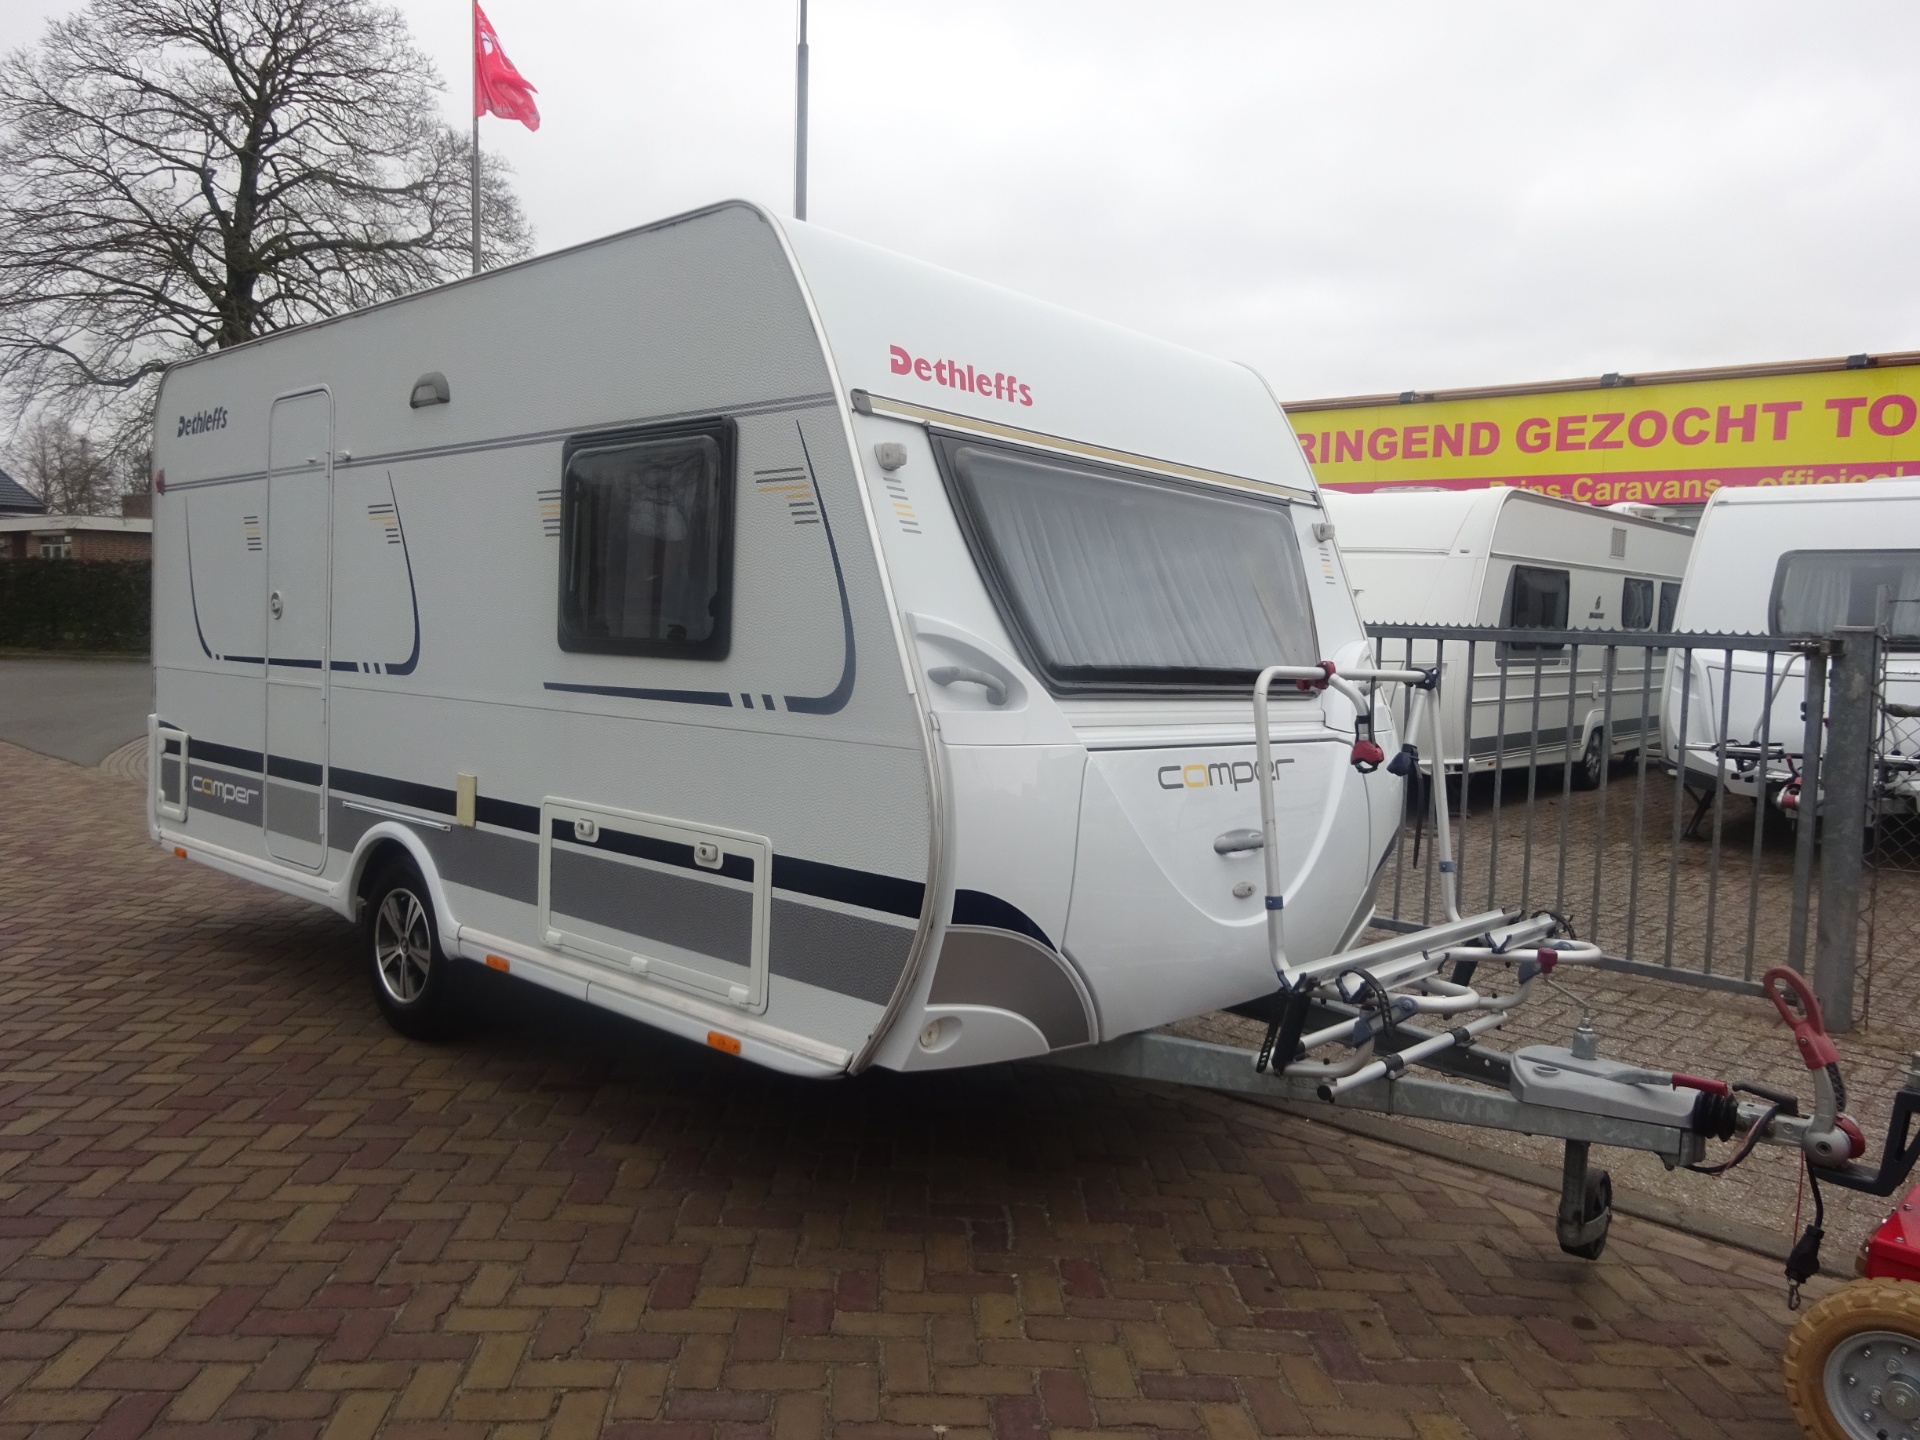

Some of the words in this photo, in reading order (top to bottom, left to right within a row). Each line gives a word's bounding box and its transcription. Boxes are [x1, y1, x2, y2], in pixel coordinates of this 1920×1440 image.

[889, 344, 1033, 407] Dethleffs
[177, 406, 228, 438] Dethleffs
[1297, 421, 1501, 465] RINGEND
[1515, 401, 1803, 453] GEZOCHT
[1825, 394, 1918, 438] TO
[1489, 480, 1562, 499] ins
[1572, 477, 1721, 502] Caravans
[1757, 466, 1904, 488] offici
[191, 775, 260, 805] camper
